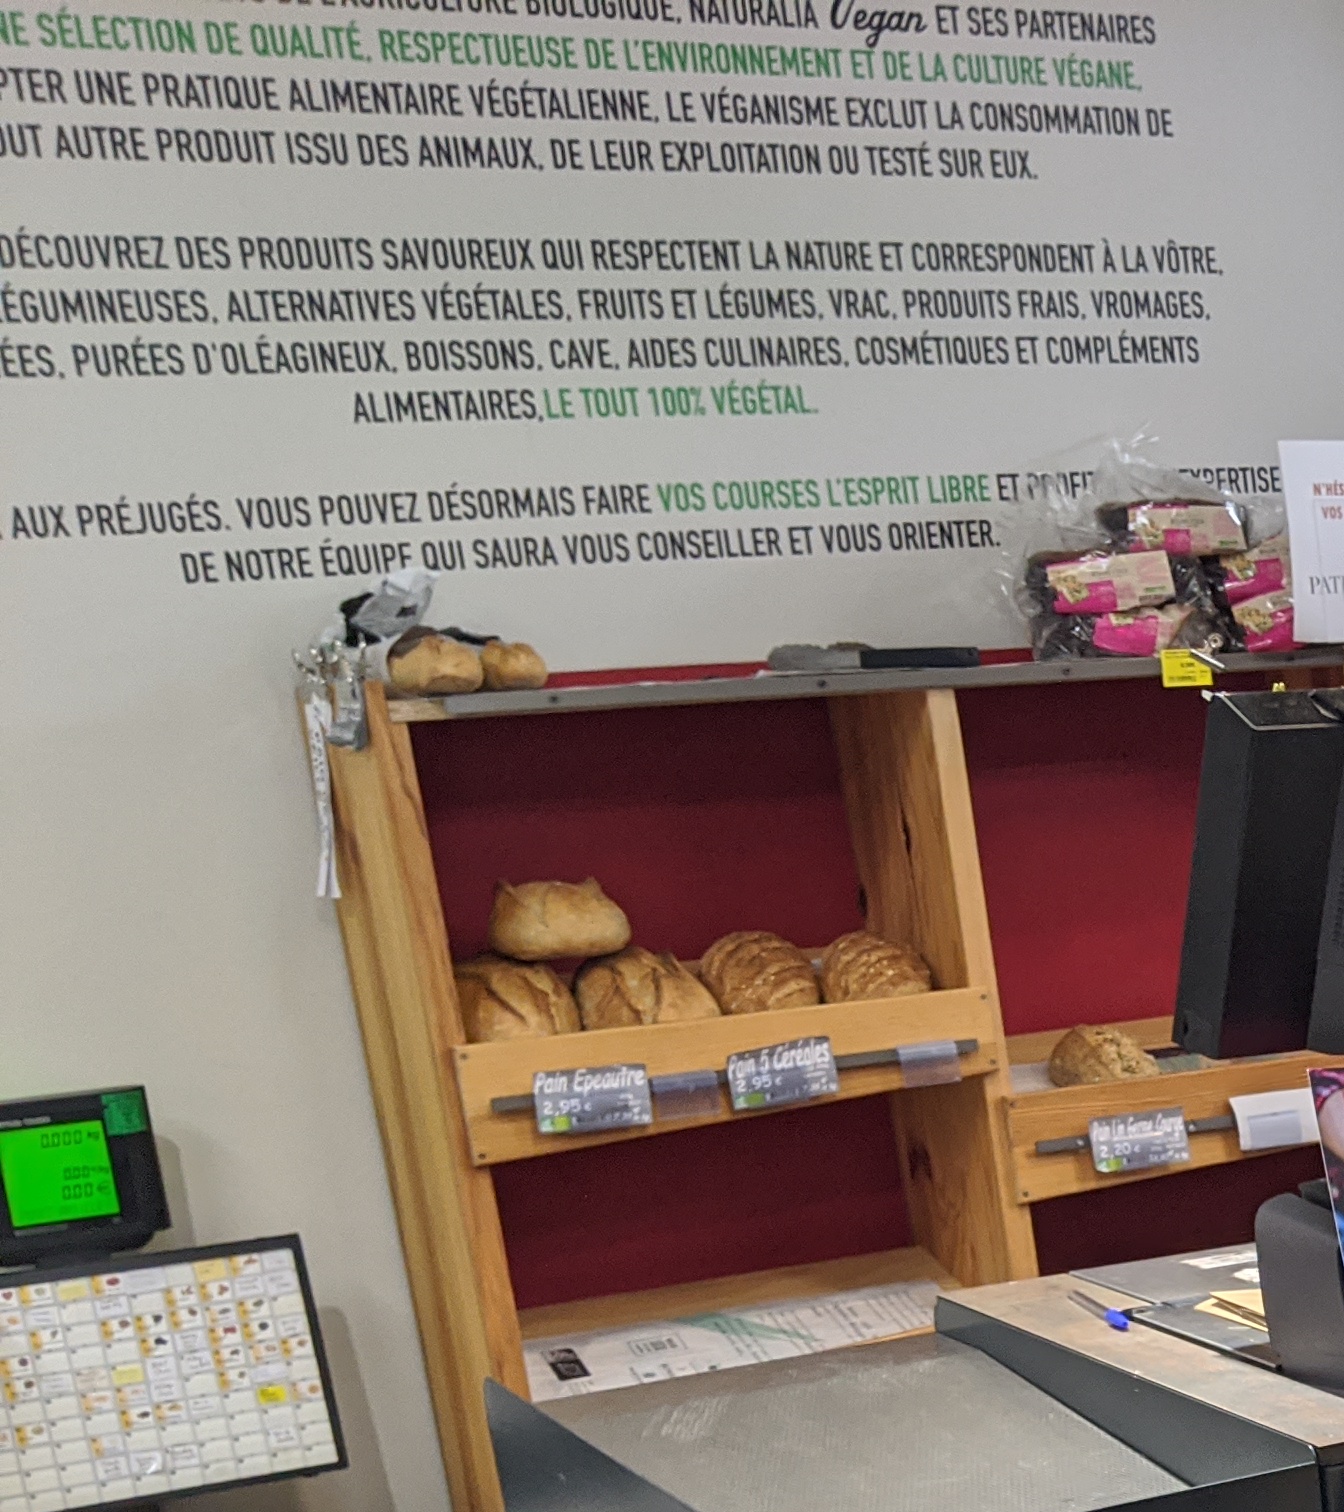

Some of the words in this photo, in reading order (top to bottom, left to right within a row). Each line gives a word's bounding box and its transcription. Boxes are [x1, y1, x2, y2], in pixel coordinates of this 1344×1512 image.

[35, 6, 198, 54] SÉLECTION
[203, 20, 244, 57] DE
[377, 28, 579, 70] RESPECTUEUSE
[0, 225, 170, 270] DÉCOUVREZ
[174, 236, 232, 270] DES
[237, 236, 375, 271] PRODUITS
[380, 237, 536, 271] SAVOUREUX
[540, 238, 584, 271] QUI
[590, 239, 741, 271] RESPECTENT
[748, 240, 781, 271] LA
[784, 240, 874, 272] NATURE
[878, 241, 904, 272] ET
[910, 241, 1095, 273] CORRESPONDENT
[1101, 237, 1117, 273] À
[1120, 245, 1149, 274] LA
[1151, 239, 1224, 276] VÔTRE,
[542, 387, 576, 420] LE
[578, 386, 639, 418] TOUT
[647, 386, 707, 417] 100%
[710, 379, 819, 416] VÉGÉTAL.
[12, 505, 71, 540] AUX
[75, 492, 231, 537] PRÉJUGÉS.
[235, 496, 312, 530] VOUS
[318, 491, 422, 526] POUVEZ
[426, 482, 576, 522] DÉSORMAIS
[581, 483, 653, 516] FAIRE
[656, 481, 707, 513] VOS
[712, 478, 821, 512] COURSES
[825, 475, 920, 508] L'ESPRIT
[926, 473, 992, 504] LIBRE
[1321, 506, 1343, 520] VOS
[534, 1071, 569, 1094] Pain
